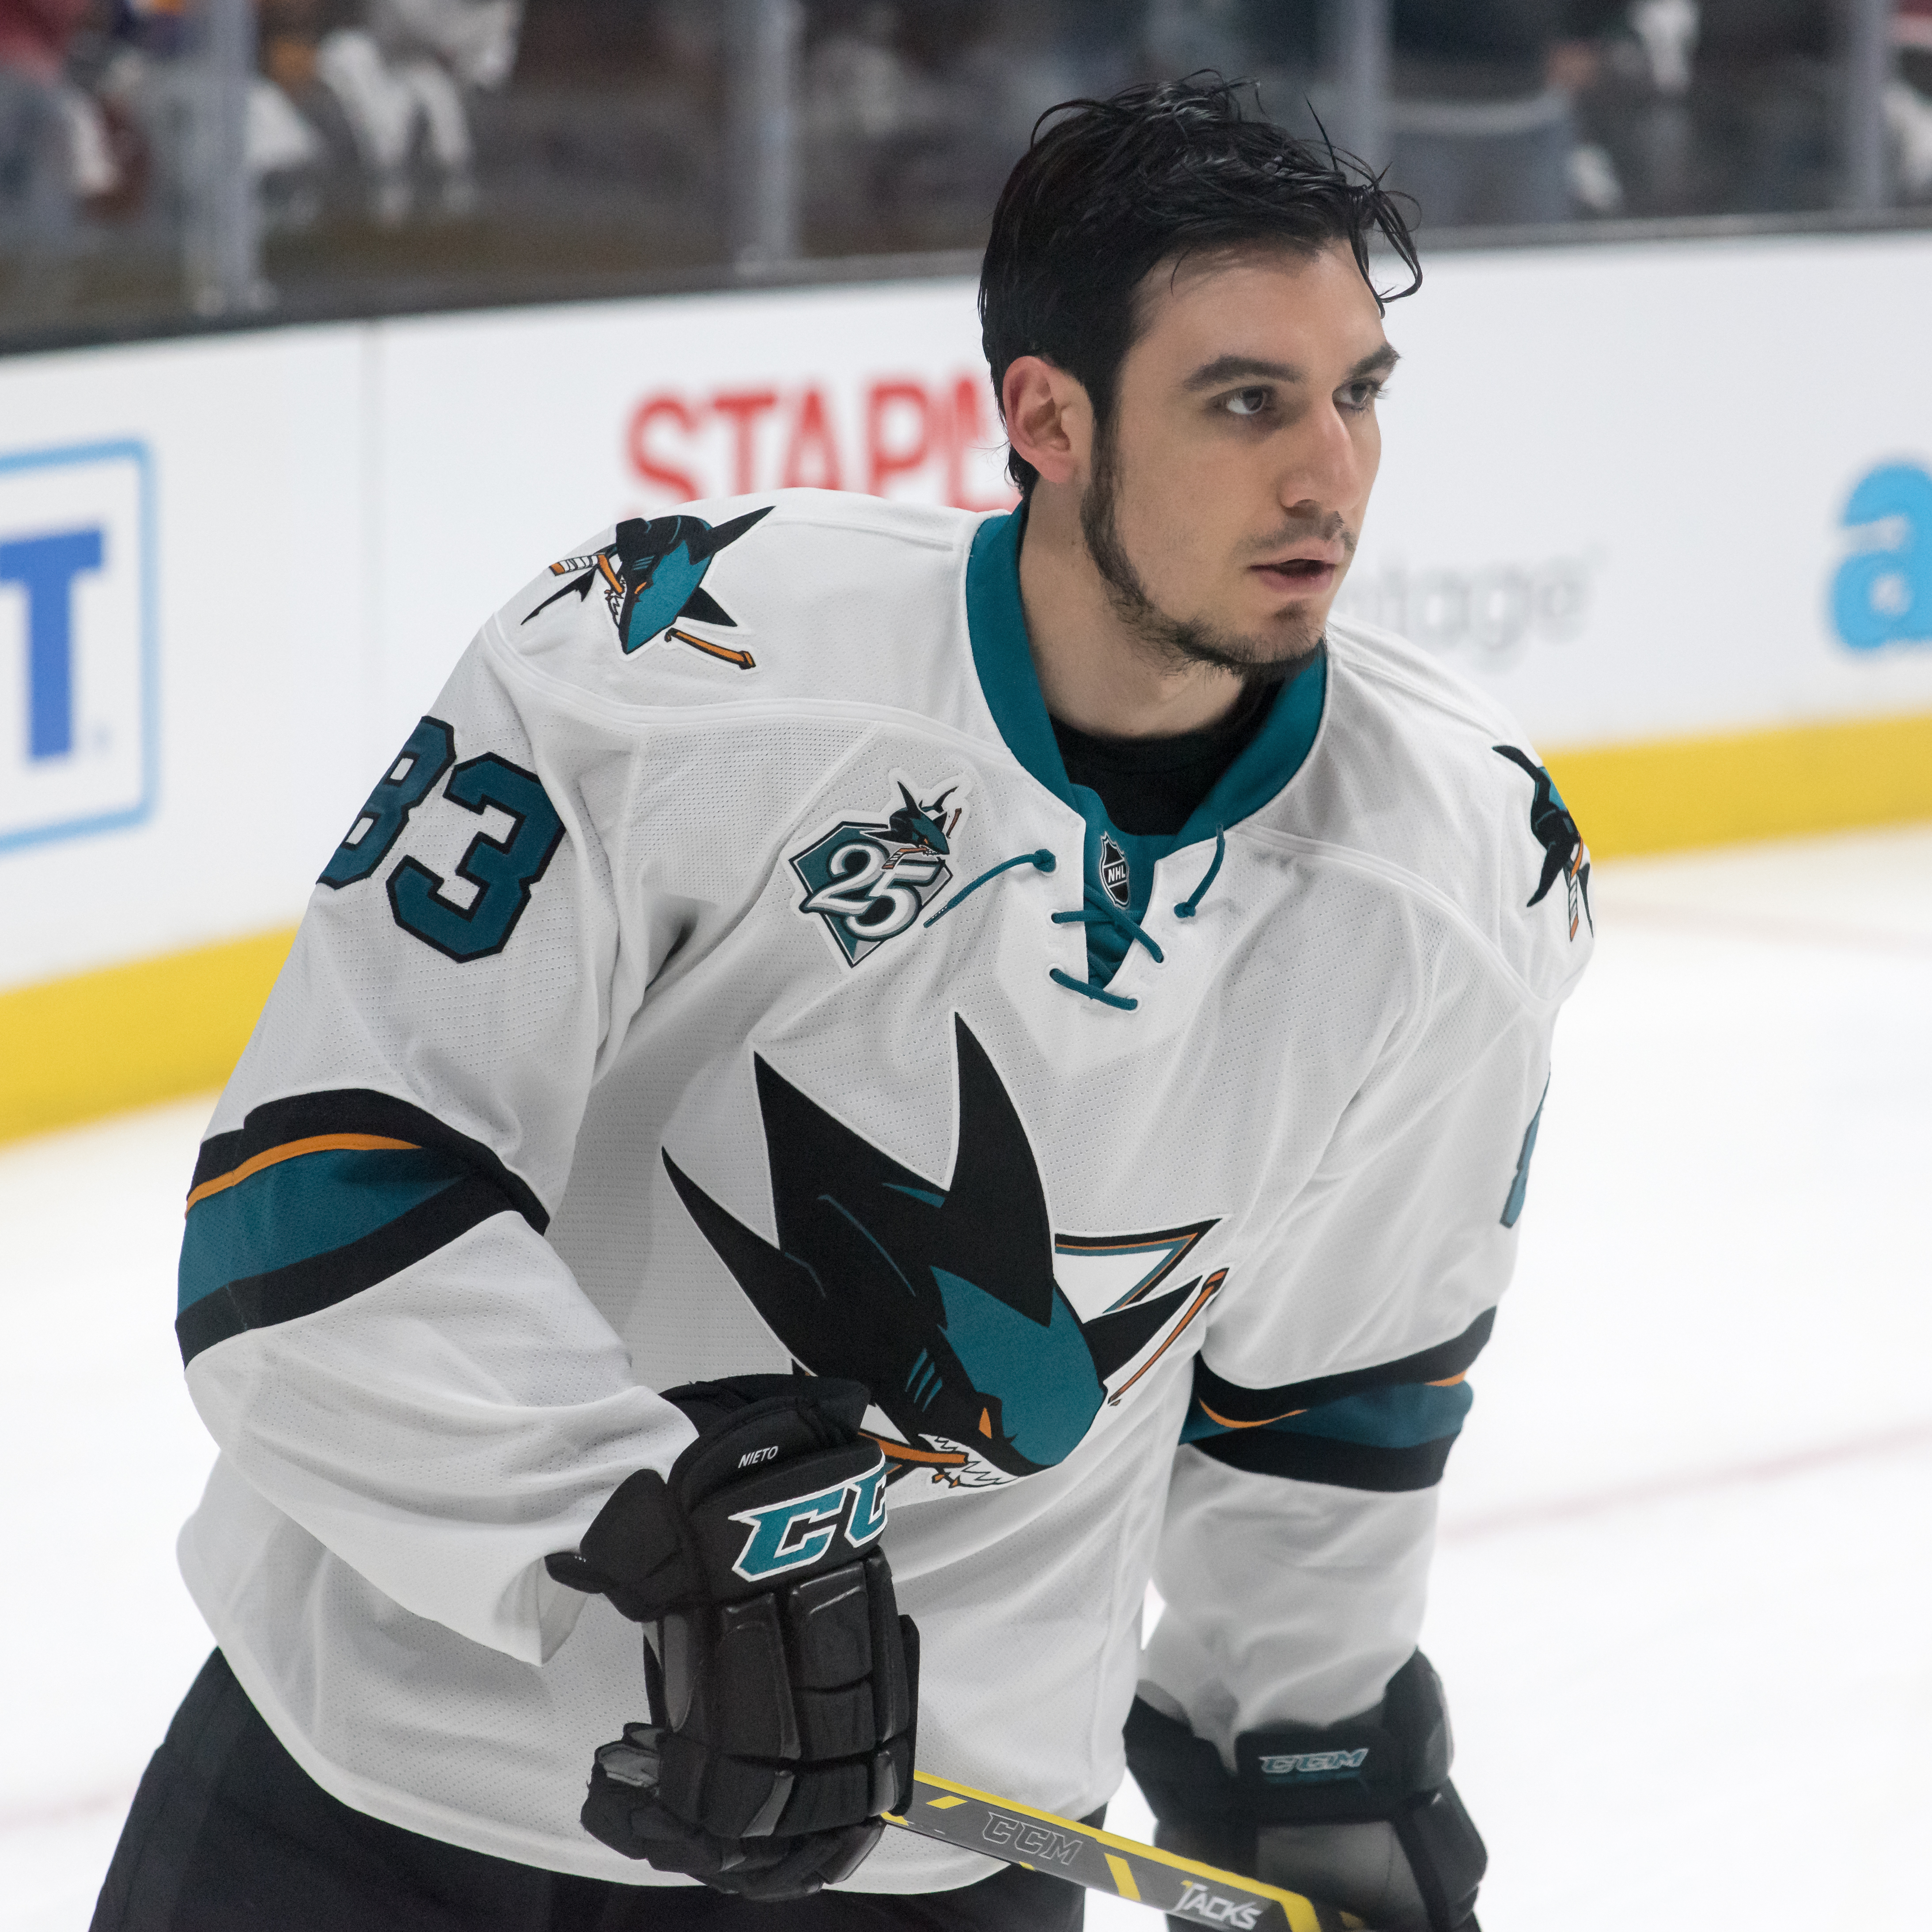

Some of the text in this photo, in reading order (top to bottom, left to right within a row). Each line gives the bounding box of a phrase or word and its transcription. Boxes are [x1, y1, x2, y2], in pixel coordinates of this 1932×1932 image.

[316, 715, 567, 964] 83
[799, 839, 946, 942] 25
[1108, 865, 1126, 883] NHL
[738, 1446, 779, 1468] NIETO
[982, 1811, 1083, 1865] CCM
